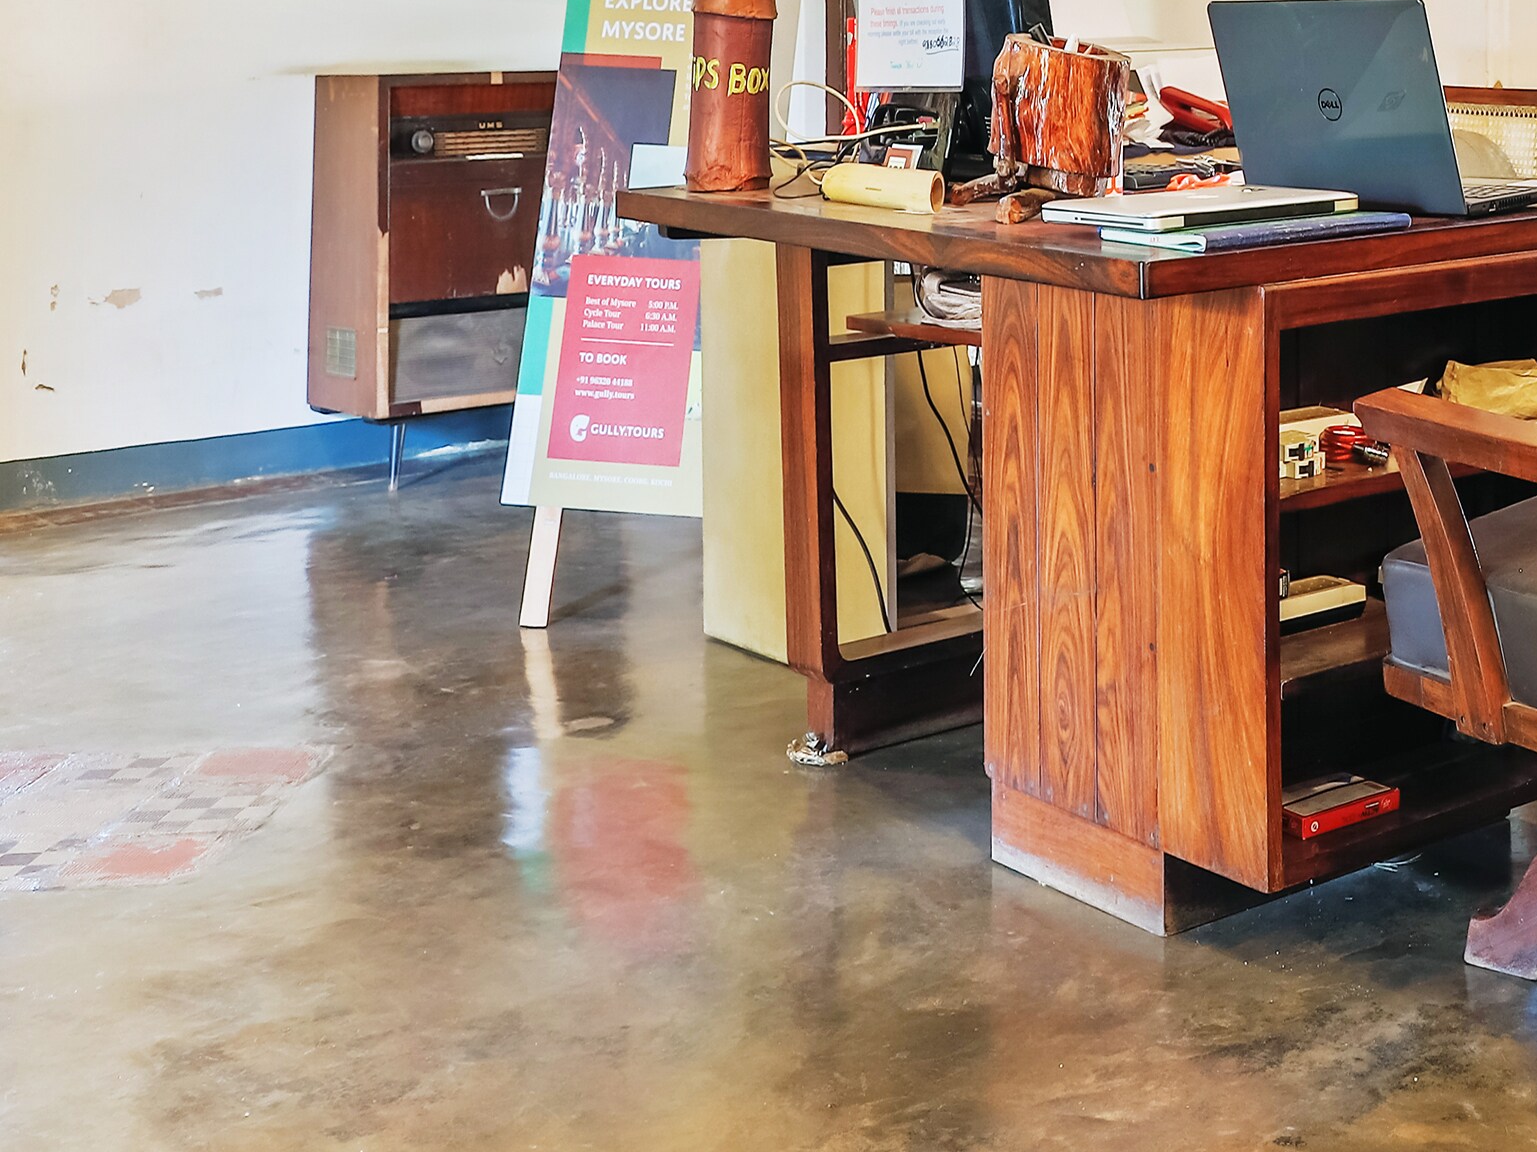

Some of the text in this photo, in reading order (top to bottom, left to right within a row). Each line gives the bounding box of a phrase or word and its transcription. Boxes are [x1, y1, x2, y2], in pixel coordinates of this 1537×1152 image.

[601, 20, 685, 42] MYSORE
[727, 63, 769, 97] BOX
[1321, 101, 1339, 109] DELL
[587, 273, 682, 290] EVERYDAY TOURS
[586, 296, 600, 305] Best
[601, 297, 609, 306] of
[610, 298, 637, 308] Mysore
[584, 308, 603, 318] Cycle
[604, 309, 621, 318] Tour
[583, 319, 605, 328] Palace
[607, 321, 624, 330] Tour
[579, 351, 627, 365] TO BOOK
[575, 389, 635, 400] www.gully.tours
[590, 423, 665, 439] GULLY.TOURS
